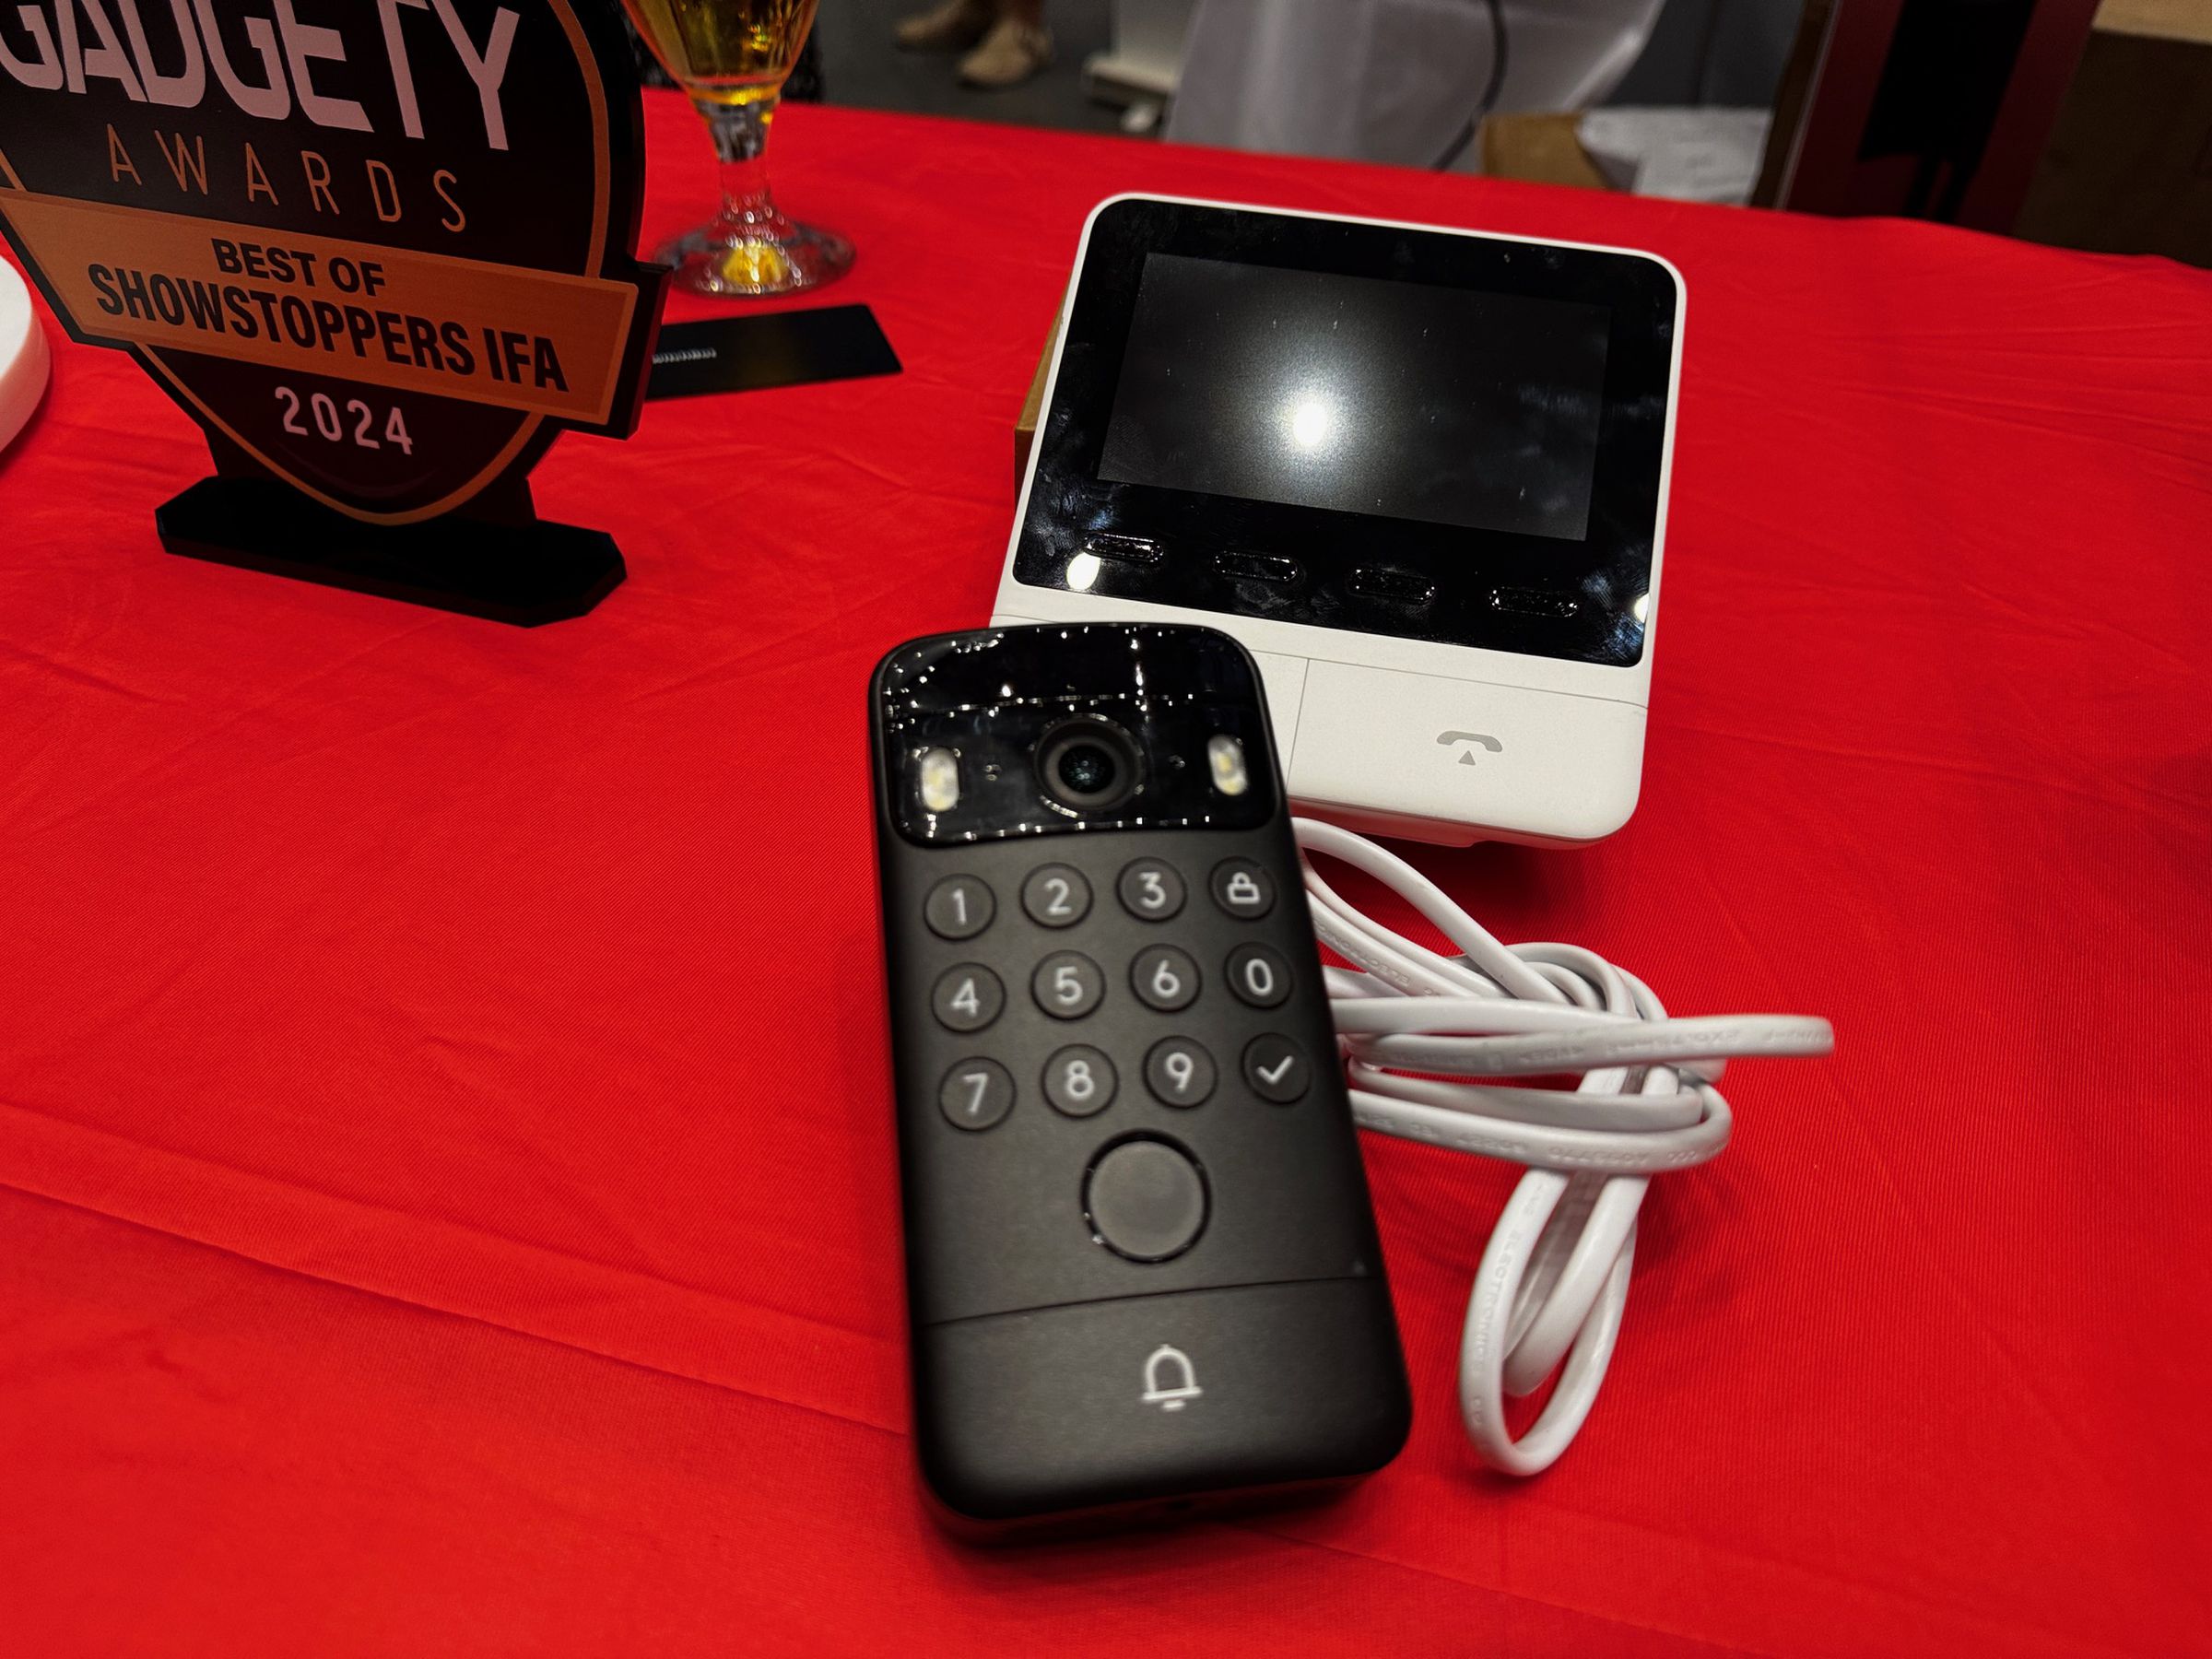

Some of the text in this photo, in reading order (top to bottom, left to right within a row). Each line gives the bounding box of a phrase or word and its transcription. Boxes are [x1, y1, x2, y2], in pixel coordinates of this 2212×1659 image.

[106, 124, 465, 232] AWARDS
[211, 238, 385, 297] BEST OF
[88, 263, 570, 393] SHOWSTOPPERS IFA
[275, 385, 414, 455] 2024
[952, 871, 1167, 925] 1 2 3
[951, 958, 1274, 1017] 4 5 6 0
[962, 1052, 1194, 1114] 7 8 9
